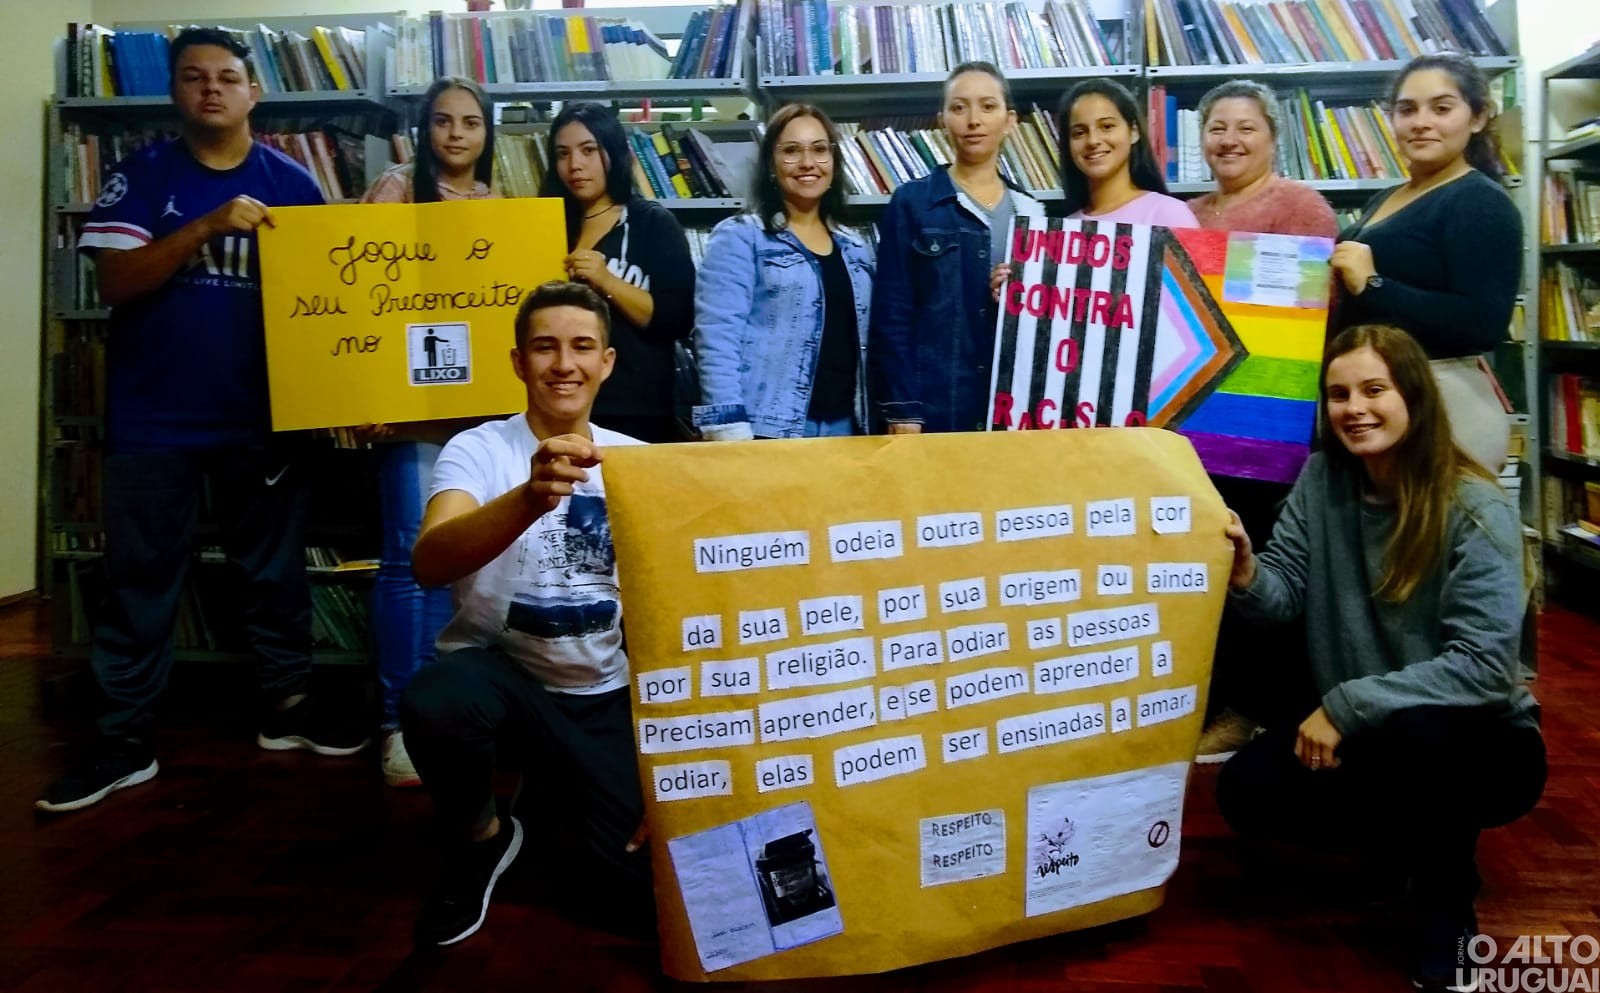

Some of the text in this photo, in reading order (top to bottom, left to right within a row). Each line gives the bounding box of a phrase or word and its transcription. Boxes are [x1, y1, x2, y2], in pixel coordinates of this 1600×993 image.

[328, 235, 494, 285] Jogue o
[1012, 228, 1134, 271] UNIDOS
[290, 282, 526, 319] seu Preconceito
[1005, 281, 1135, 329] CONTRA
[331, 334, 382, 356] no
[1055, 338, 1080, 374] O
[419, 367, 461, 381] LIXO
[699, 503, 1187, 568] Ninguém odeia outra pessoa pela cor
[687, 567, 1205, 646] da sua pele, por sua origem ou ainda
[646, 610, 1151, 701] por sua religião. Para odiar as pessoas
[645, 652, 1168, 744] Precisam aprender, e se podem aprender a
[658, 693, 1191, 793] odiar, elas podem ser ensinadas a amar.
[931, 812, 993, 838] RESPEITO
[932, 842, 994, 869] RESPEITO
[1035, 852, 1080, 878] respeito
